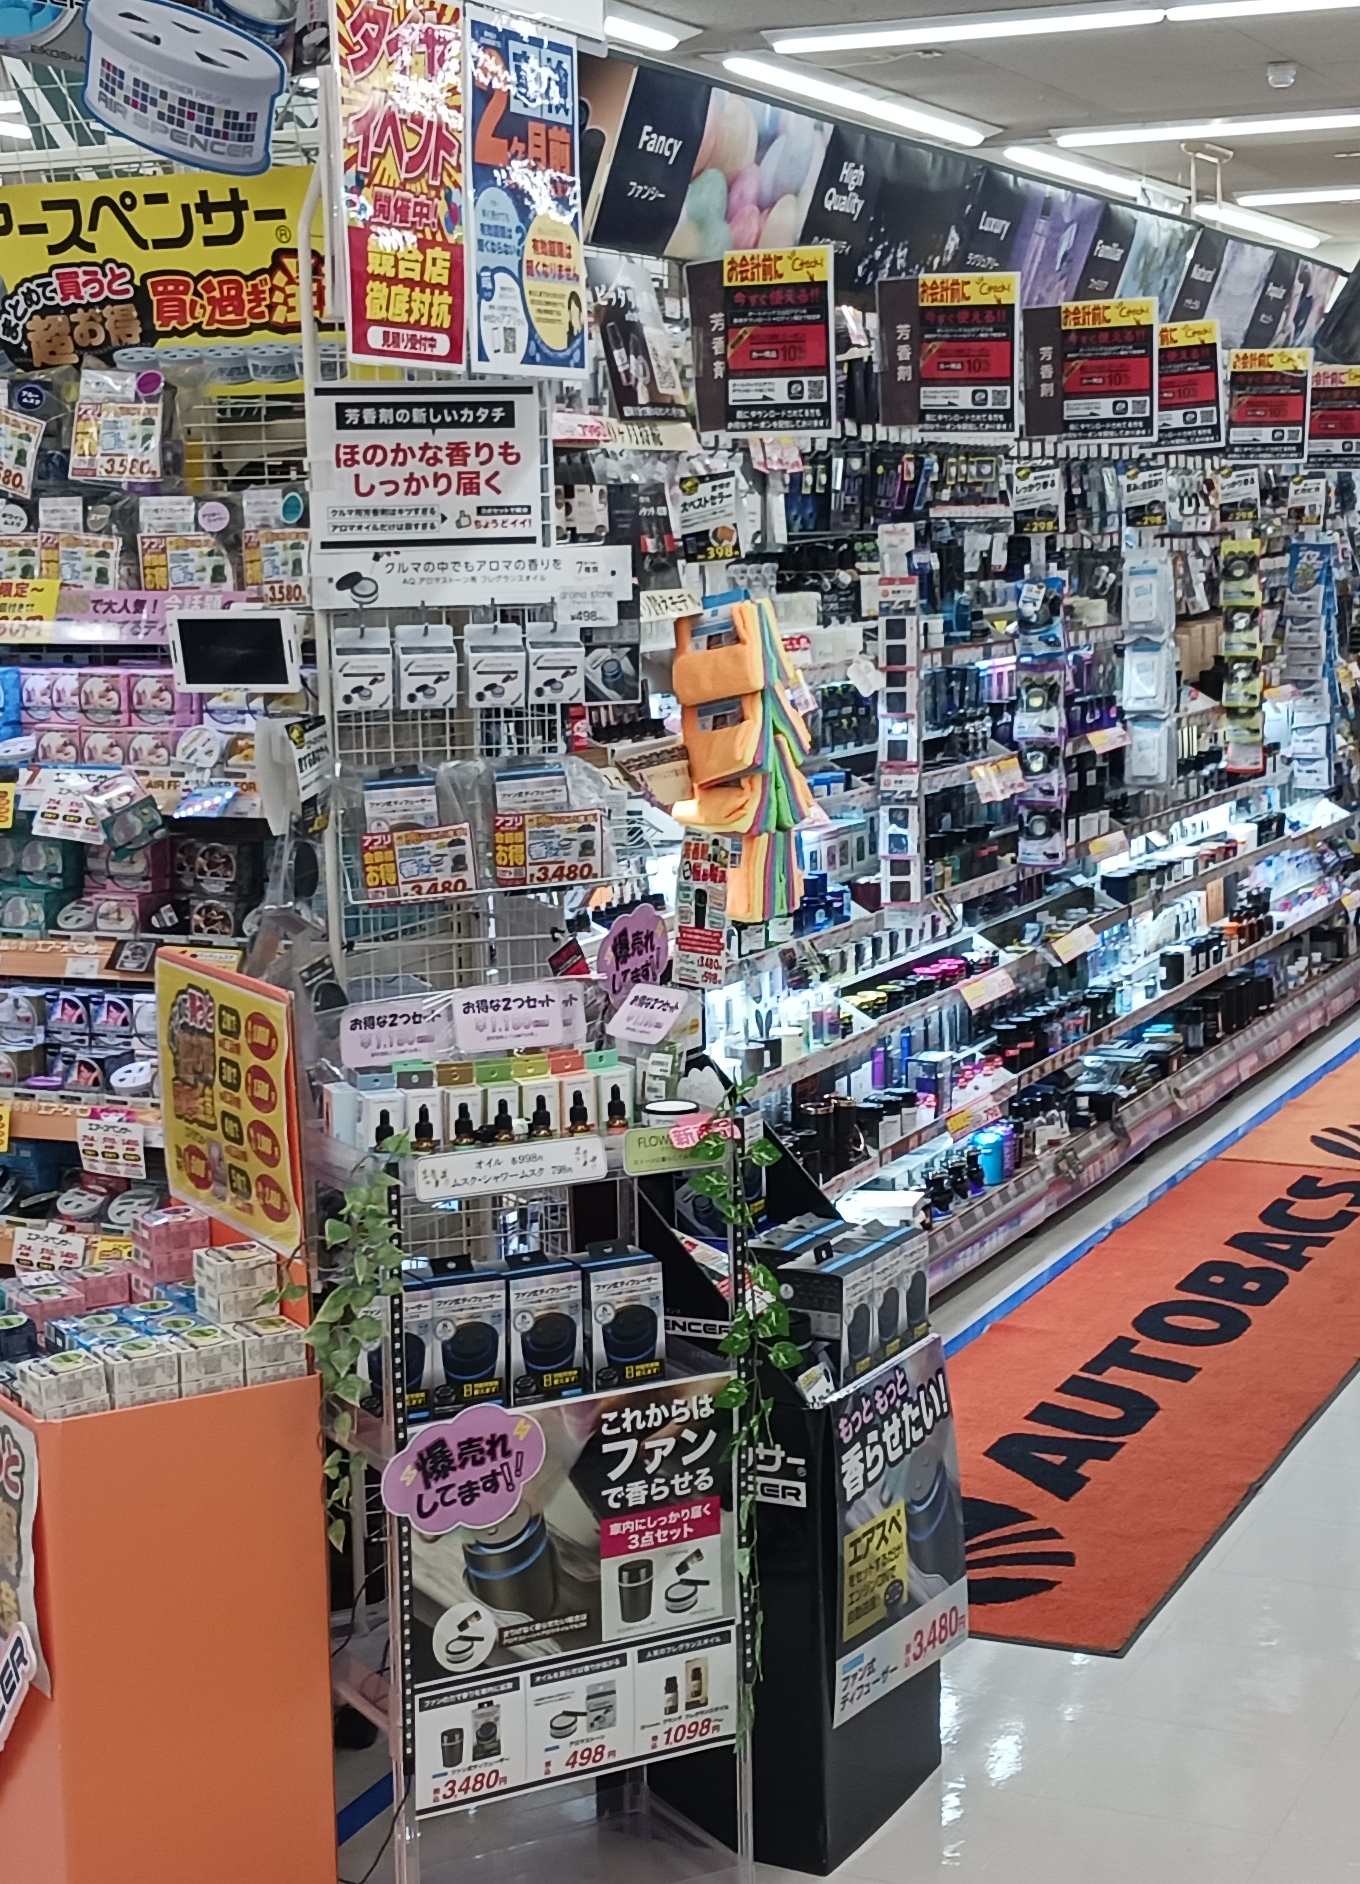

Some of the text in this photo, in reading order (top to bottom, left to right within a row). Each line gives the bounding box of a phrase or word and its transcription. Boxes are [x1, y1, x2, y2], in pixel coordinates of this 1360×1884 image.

[97, 90, 255, 159] AIR SPENCER
[346, 101, 459, 186] イベント
[638, 125, 683, 164] Fancy
[841, 160, 864, 188] High
[371, 187, 439, 227] 開催中!
[627, 181, 667, 201] ファンシー
[823, 187, 865, 221] Quality
[978, 211, 1011, 241] Luxury
[367, 237, 451, 285] 競合店
[727, 254, 784, 283] お会計前に
[366, 285, 453, 327] 徹底対抗
[919, 279, 971, 303] お会計前に
[26, 304, 142, 368] 超お得
[896, 323, 912, 382] 芳香剤
[345, 406, 507, 426] 芳香剤の新しいカタチ
[335, 441, 522, 469] ほのかな香りも
[353, 471, 504, 498] しっかり届く
[473, 518, 532, 530] ちょうどイイ!
[384, 558, 563, 575] クルマの中でもアロマの香りを
[495, 814, 525, 830] アプリ
[362, 833, 393, 847] アプリ
[462, 994, 557, 1016] お得な2つセット
[349, 1010, 443, 1034] お得な2つセット
[451, 1167, 546, 1189] ムスク・シャワームスク
[474, 1157, 504, 1171] オイル
[601, 1394, 716, 1436] これからは
[839, 1367, 909, 1444] もっと もっと
[840, 1371, 950, 1504] 香らせたい!
[415, 1431, 513, 1489] 爆売れ
[601, 1428, 718, 1482] ファン
[601, 1467, 715, 1509] で香らせる
[609, 1503, 712, 1536] 車内にしっかり届く
[627, 1522, 694, 1550] 3点セット
[848, 1508, 903, 1568] エアスペ
[840, 1665, 899, 1713] ディフューザー
[841, 1656, 877, 1692] ファン式
